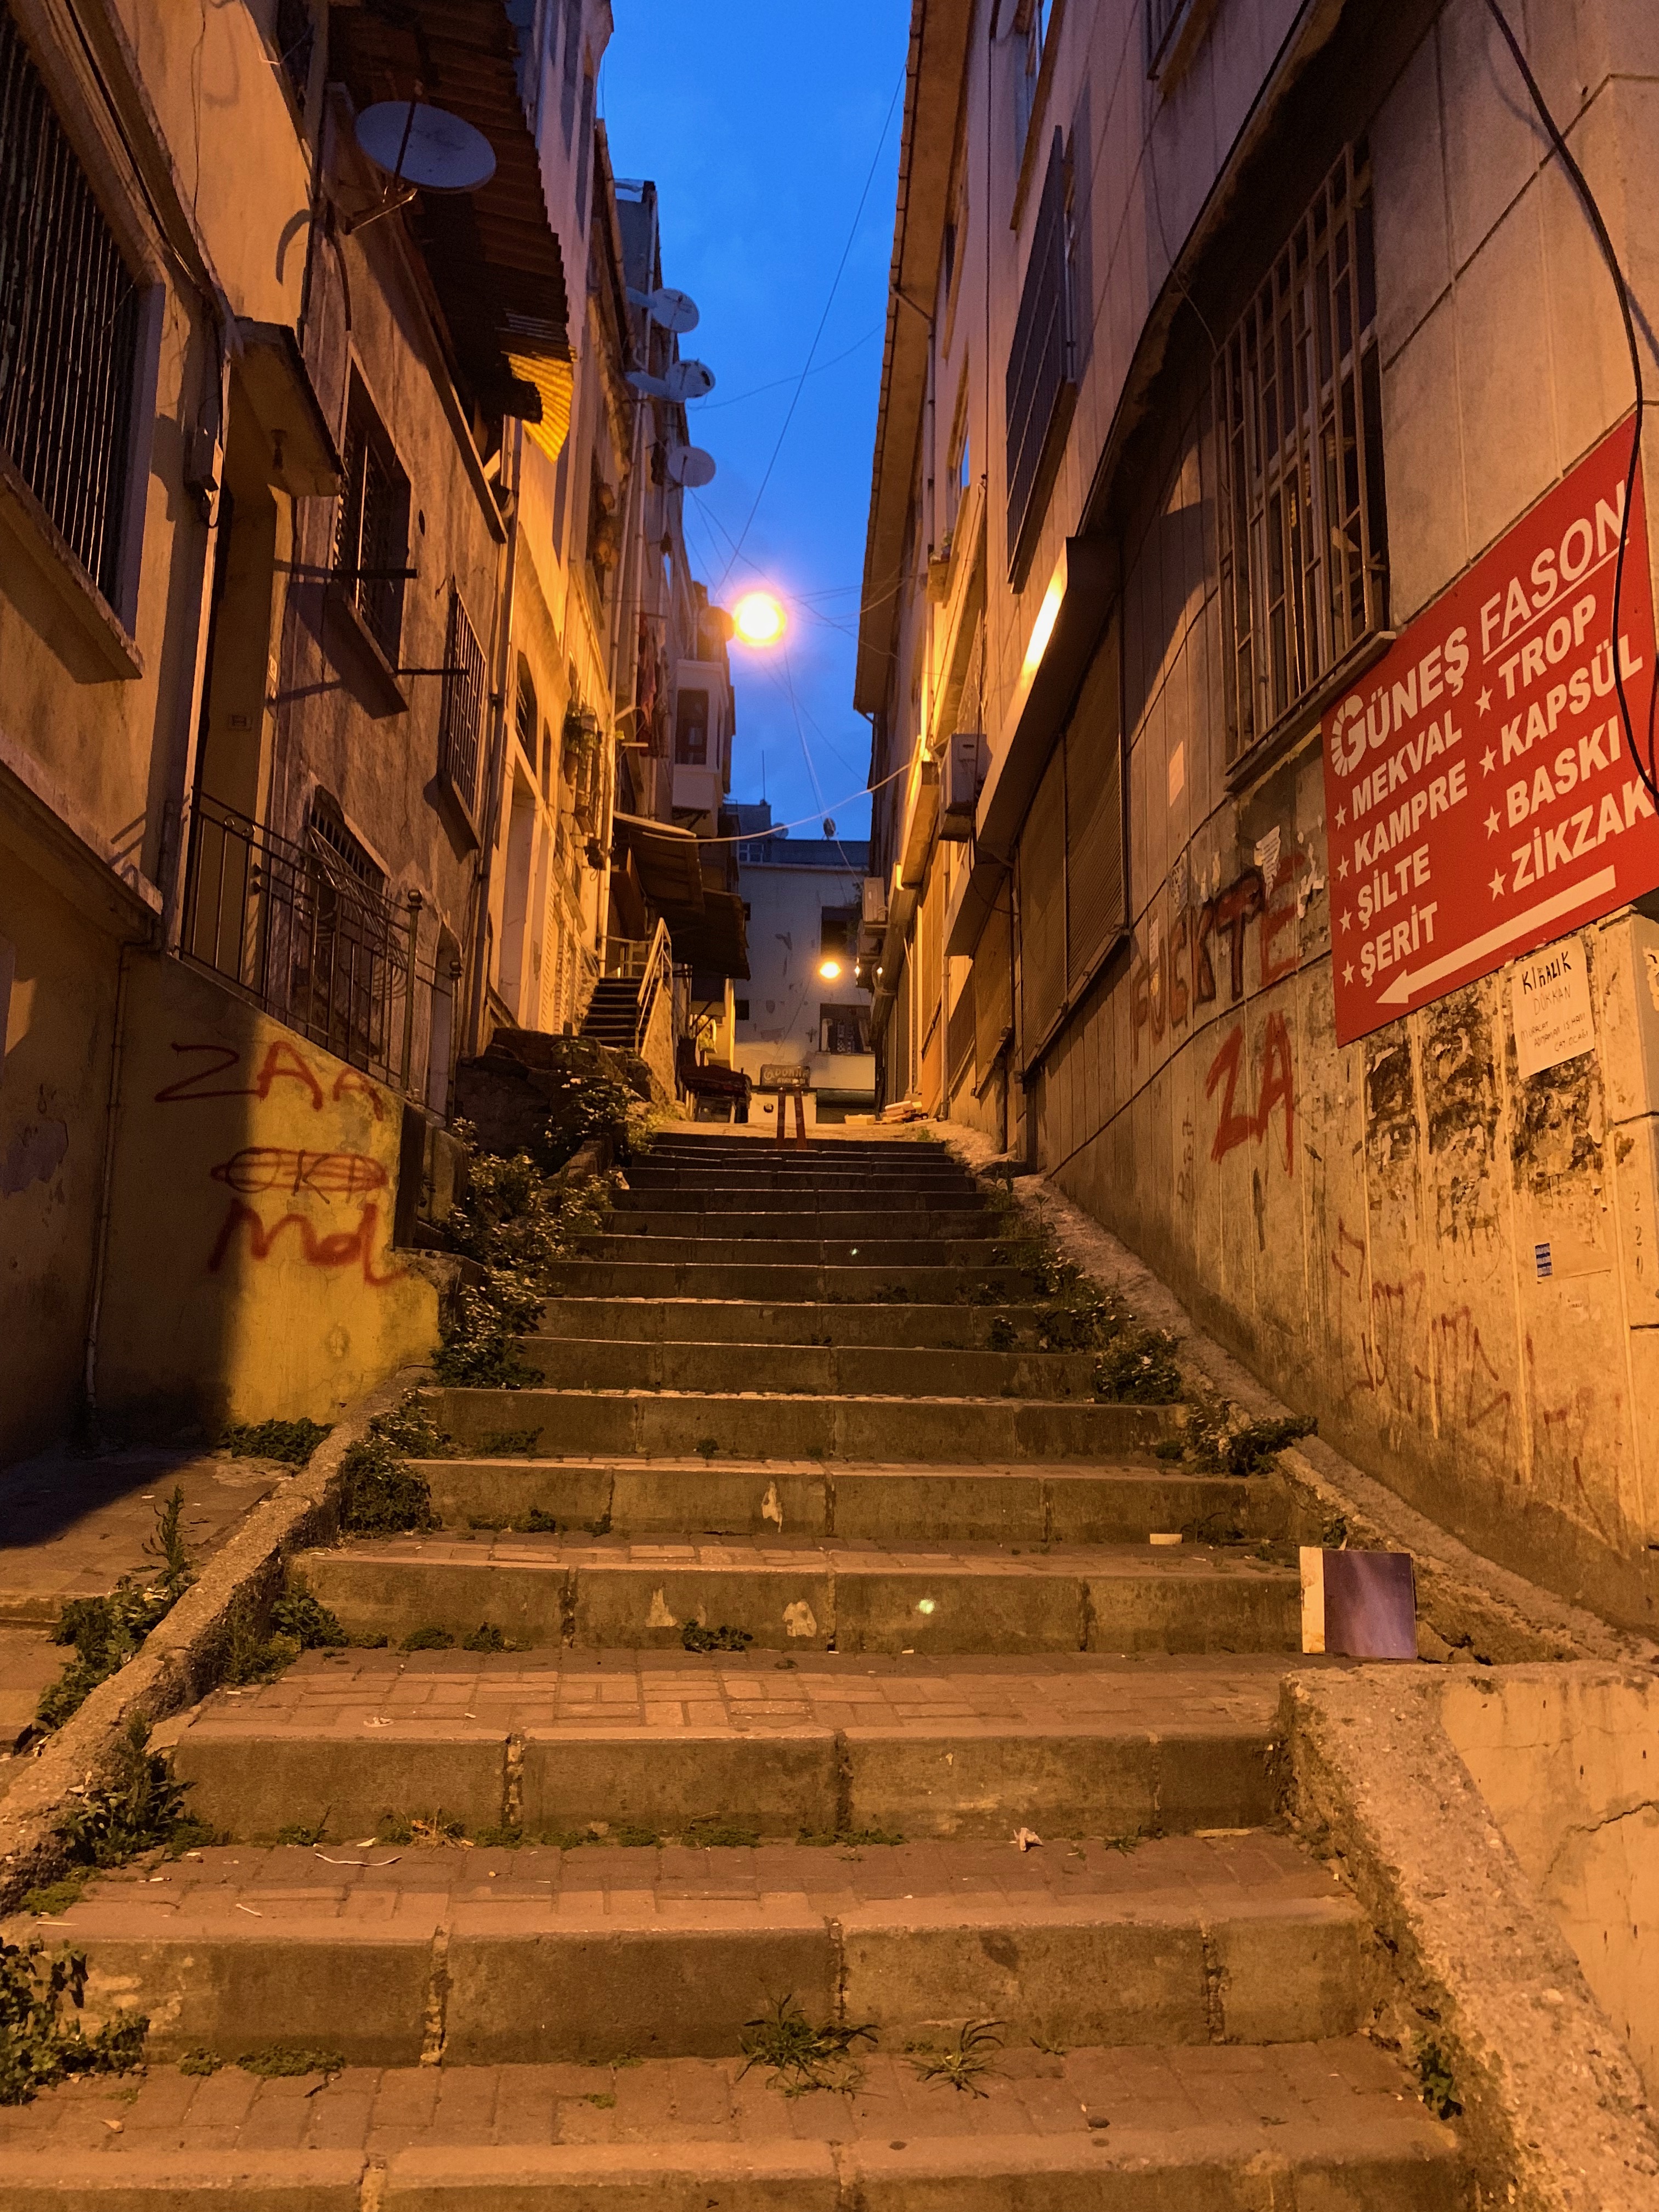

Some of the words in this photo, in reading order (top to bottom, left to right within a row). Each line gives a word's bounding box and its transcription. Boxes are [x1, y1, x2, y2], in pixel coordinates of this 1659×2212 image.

[1331, 634, 1469, 777] GÜNEŞ
[1481, 479, 1626, 656] FASON
[1498, 594, 1596, 700] TROP
[1501, 634, 1643, 766] KAPSÜL
[1352, 709, 1463, 821] MEKVAL
[1354, 759, 1468, 873] KAMPRE
[1506, 715, 1621, 828] BASKI
[1358, 843, 1431, 931] ŞİLTE
[1511, 769, 1656, 893] ZİKZAK
[1361, 901, 1438, 988] ŞERİT
